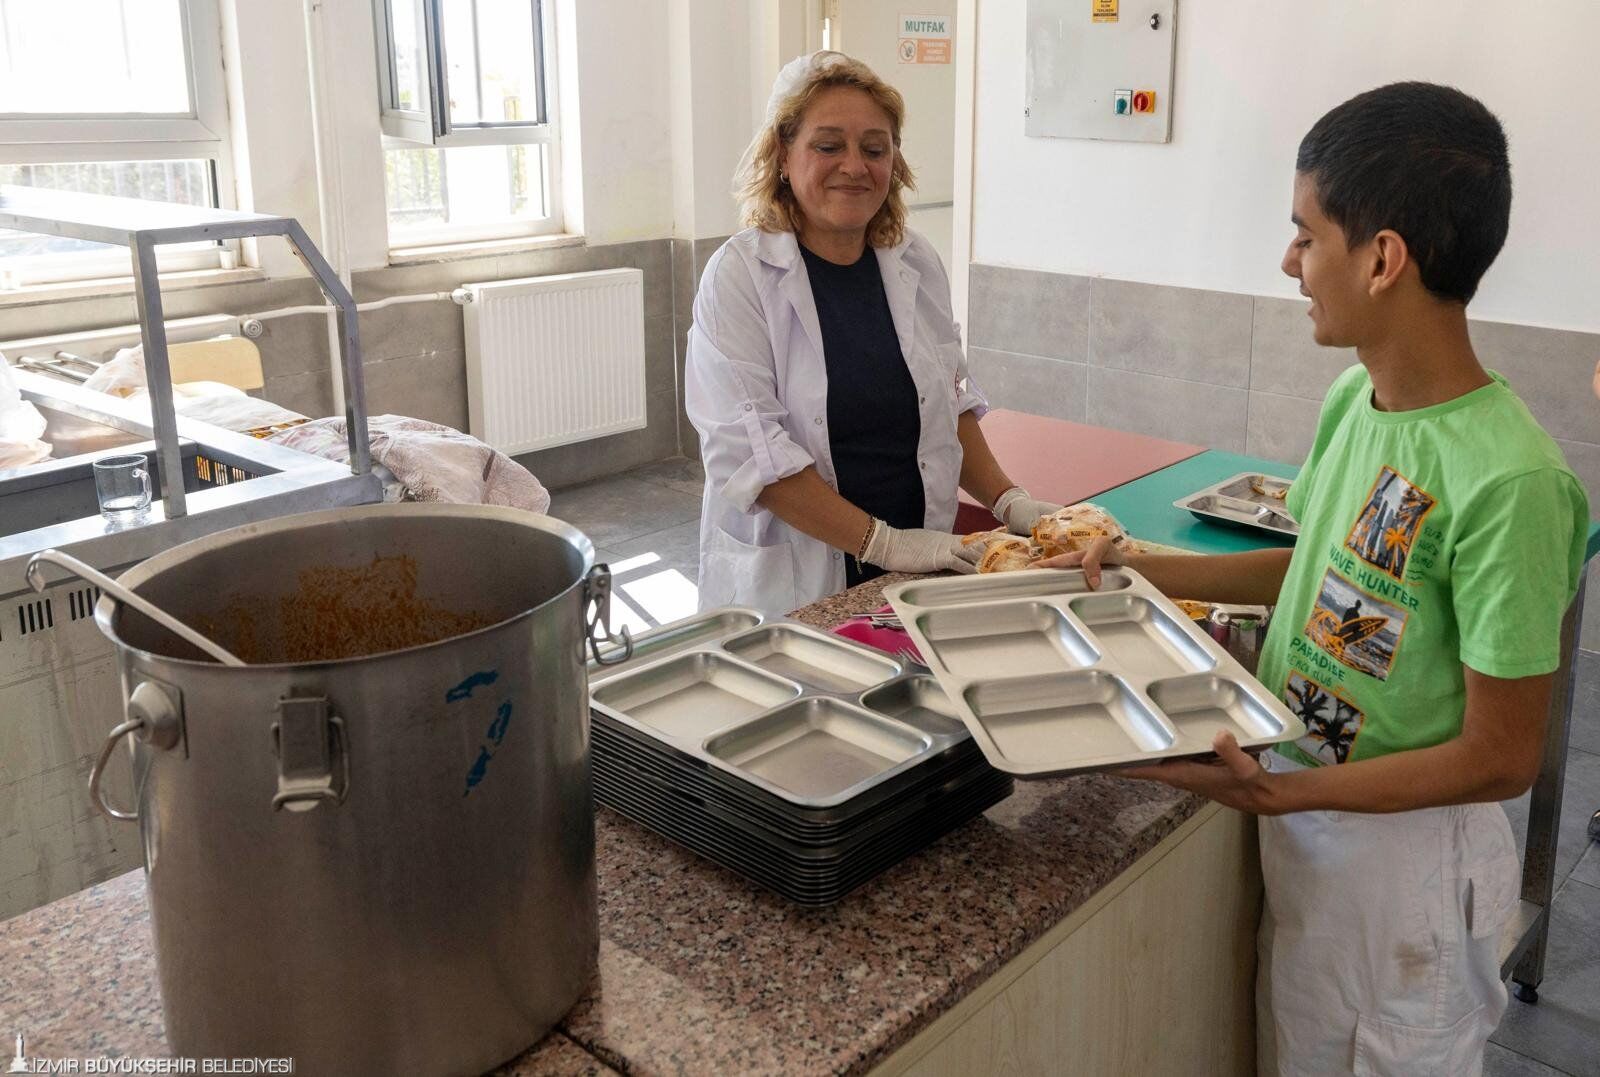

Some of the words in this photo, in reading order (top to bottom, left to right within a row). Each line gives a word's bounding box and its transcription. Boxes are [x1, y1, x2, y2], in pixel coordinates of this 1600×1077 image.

[905, 20, 945, 33] MUTFAK
[1356, 567, 1419, 612] HUNTER
[1289, 636, 1346, 682] PARADISE
